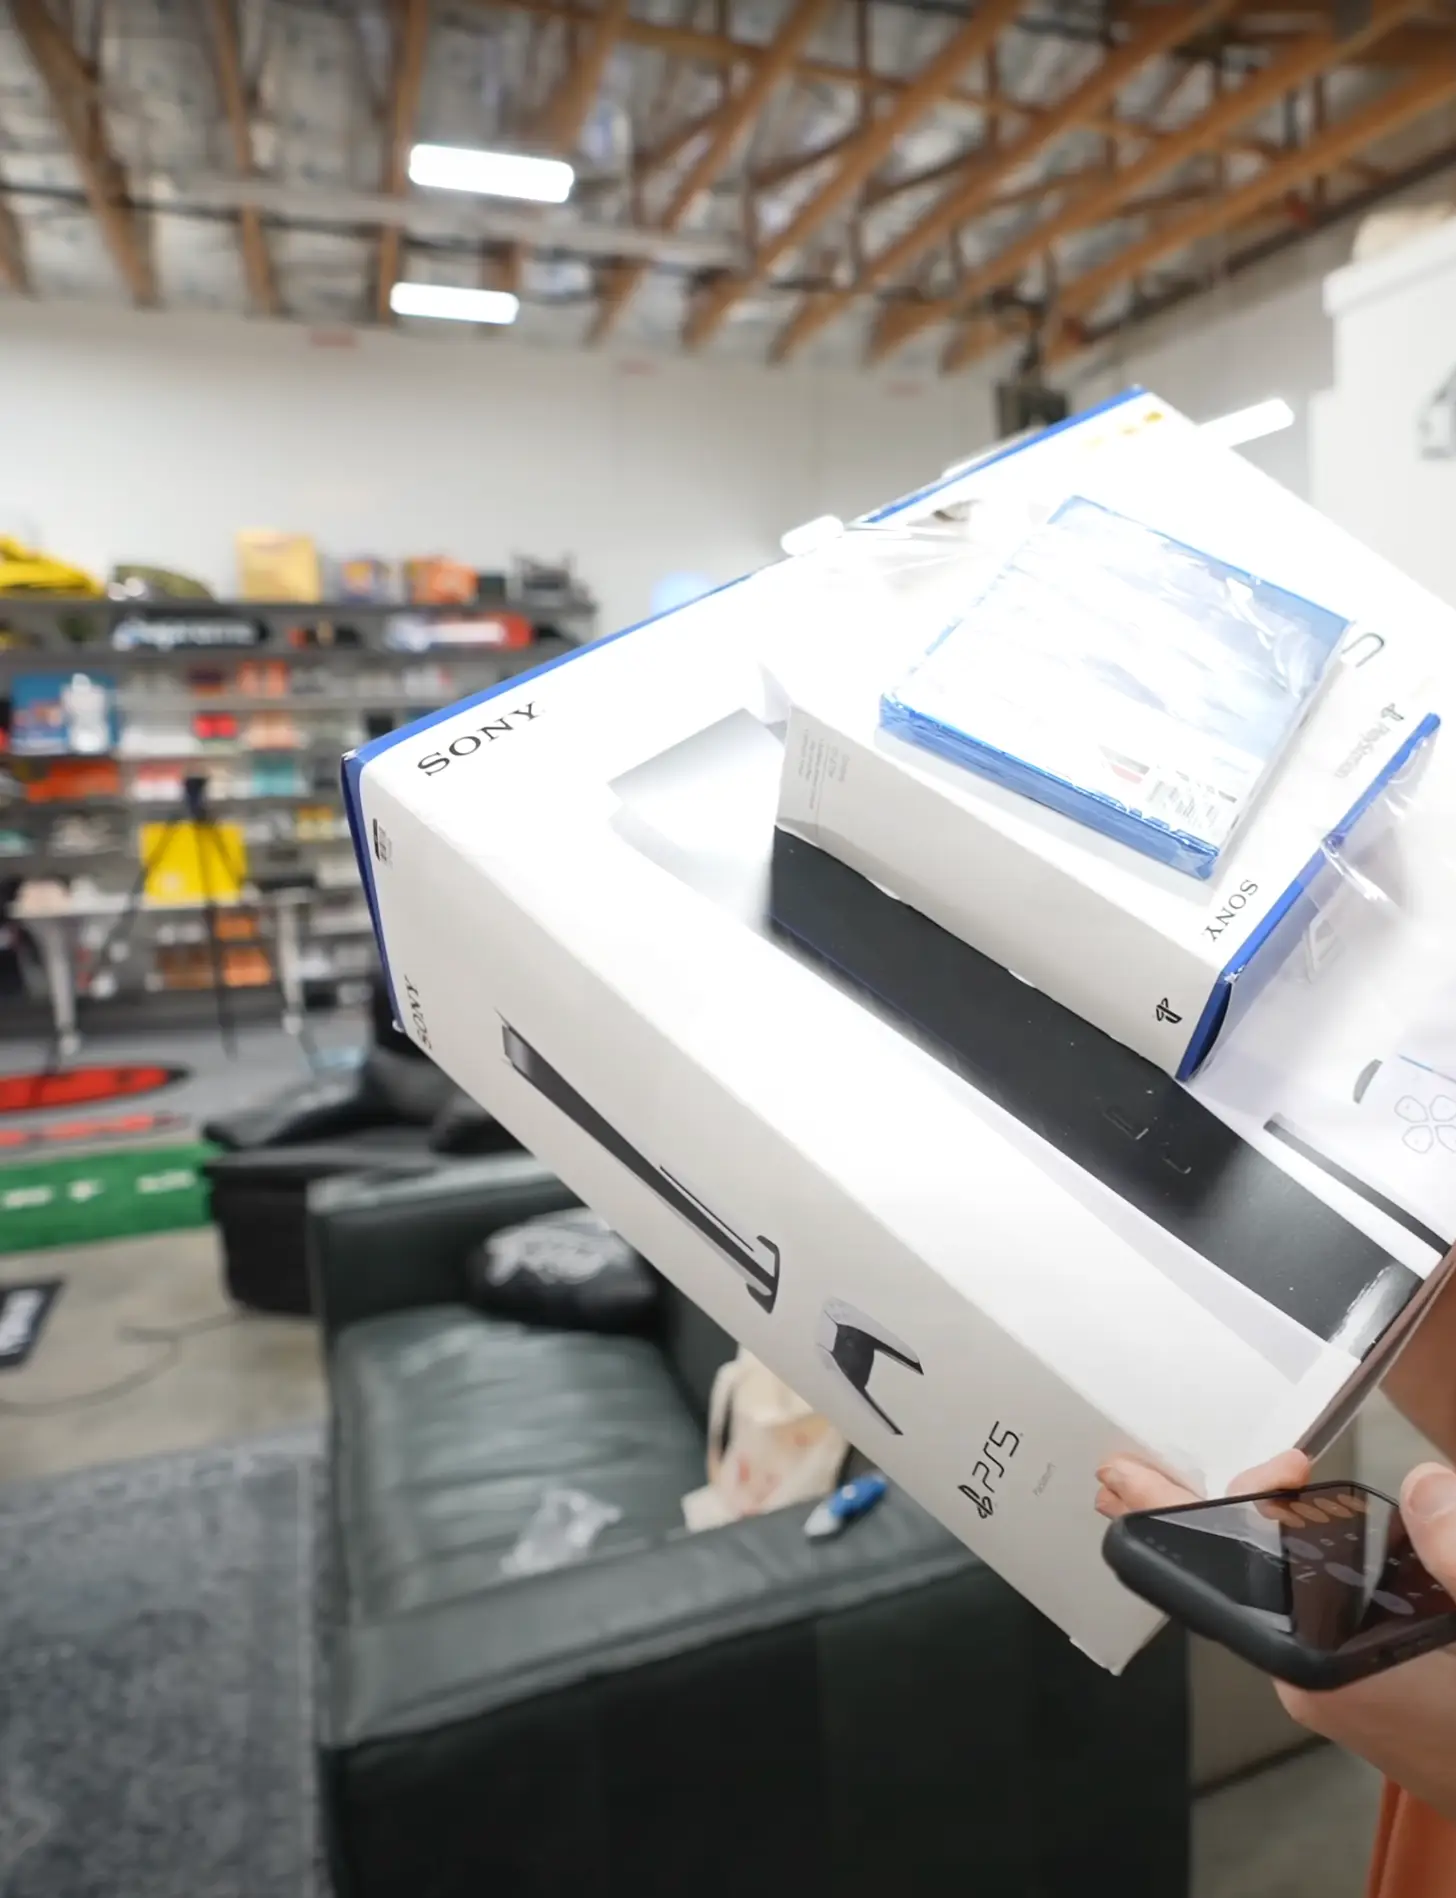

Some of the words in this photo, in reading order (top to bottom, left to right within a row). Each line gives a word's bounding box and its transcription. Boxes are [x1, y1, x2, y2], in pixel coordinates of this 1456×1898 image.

[418, 701, 540, 776] SONY
[1204, 879, 1259, 942] SONY
[404, 974, 433, 1050] SONY
[972, 1421, 1020, 1493] PS5
